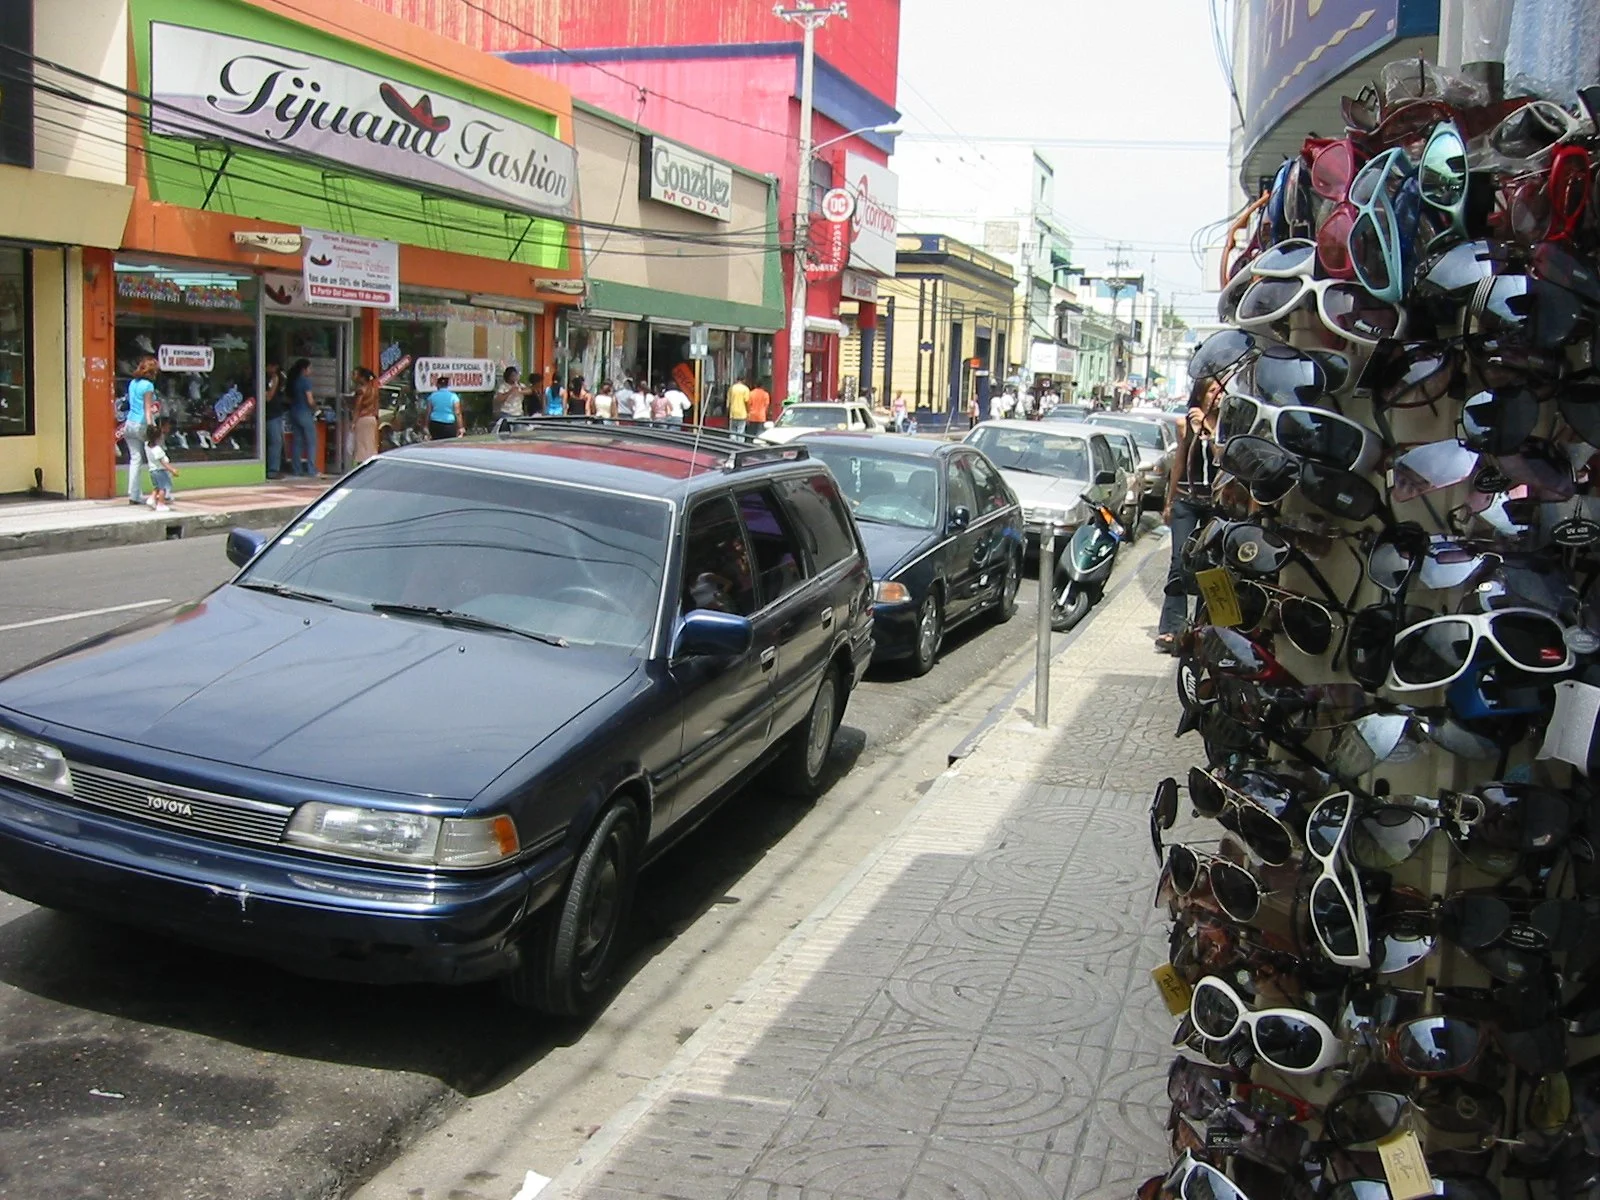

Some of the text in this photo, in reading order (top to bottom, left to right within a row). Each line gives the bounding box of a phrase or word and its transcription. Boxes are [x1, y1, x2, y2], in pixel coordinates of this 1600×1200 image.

[206, 54, 567, 198] Tijuana Fashion
[653, 145, 729, 208] González
[663, 190, 720, 216] MODA
[361, 280, 392, 290] Descuento
[451, 363, 481, 371] ESPECIAL
[146, 795, 192, 815] TOYOTA
